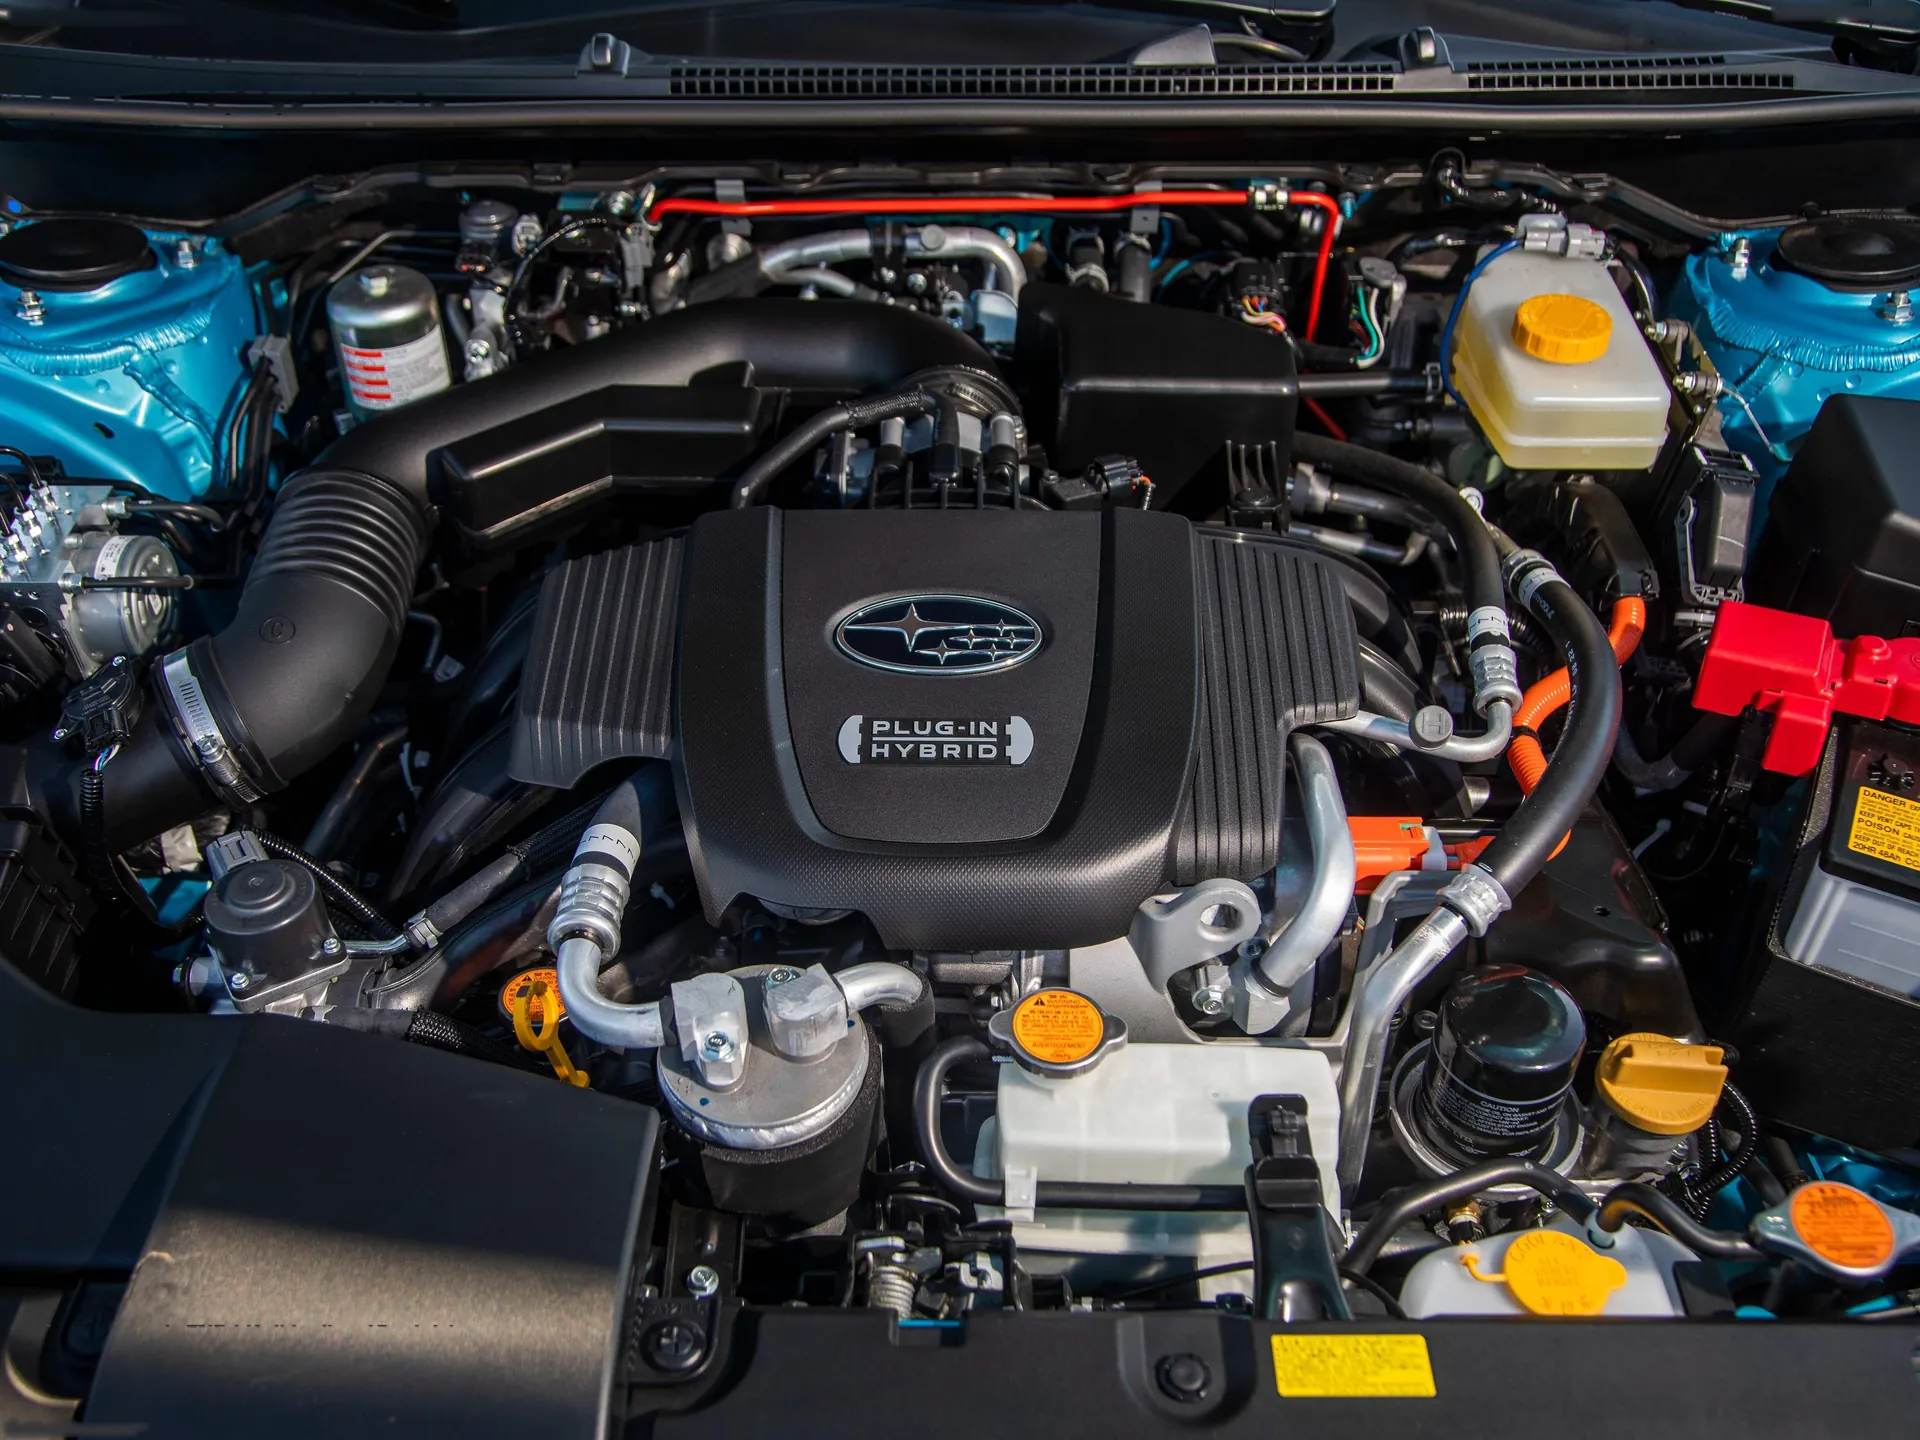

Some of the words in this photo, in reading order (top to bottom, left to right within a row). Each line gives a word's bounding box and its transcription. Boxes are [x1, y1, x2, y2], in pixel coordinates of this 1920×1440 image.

[872, 720, 998, 736] PLUG-IN
[871, 743, 998, 759] HYBRID
[1863, 789, 1907, 808] DANGER
[1857, 817, 1900, 836] POISON
[1480, 1100, 1520, 1113] CAUTION
